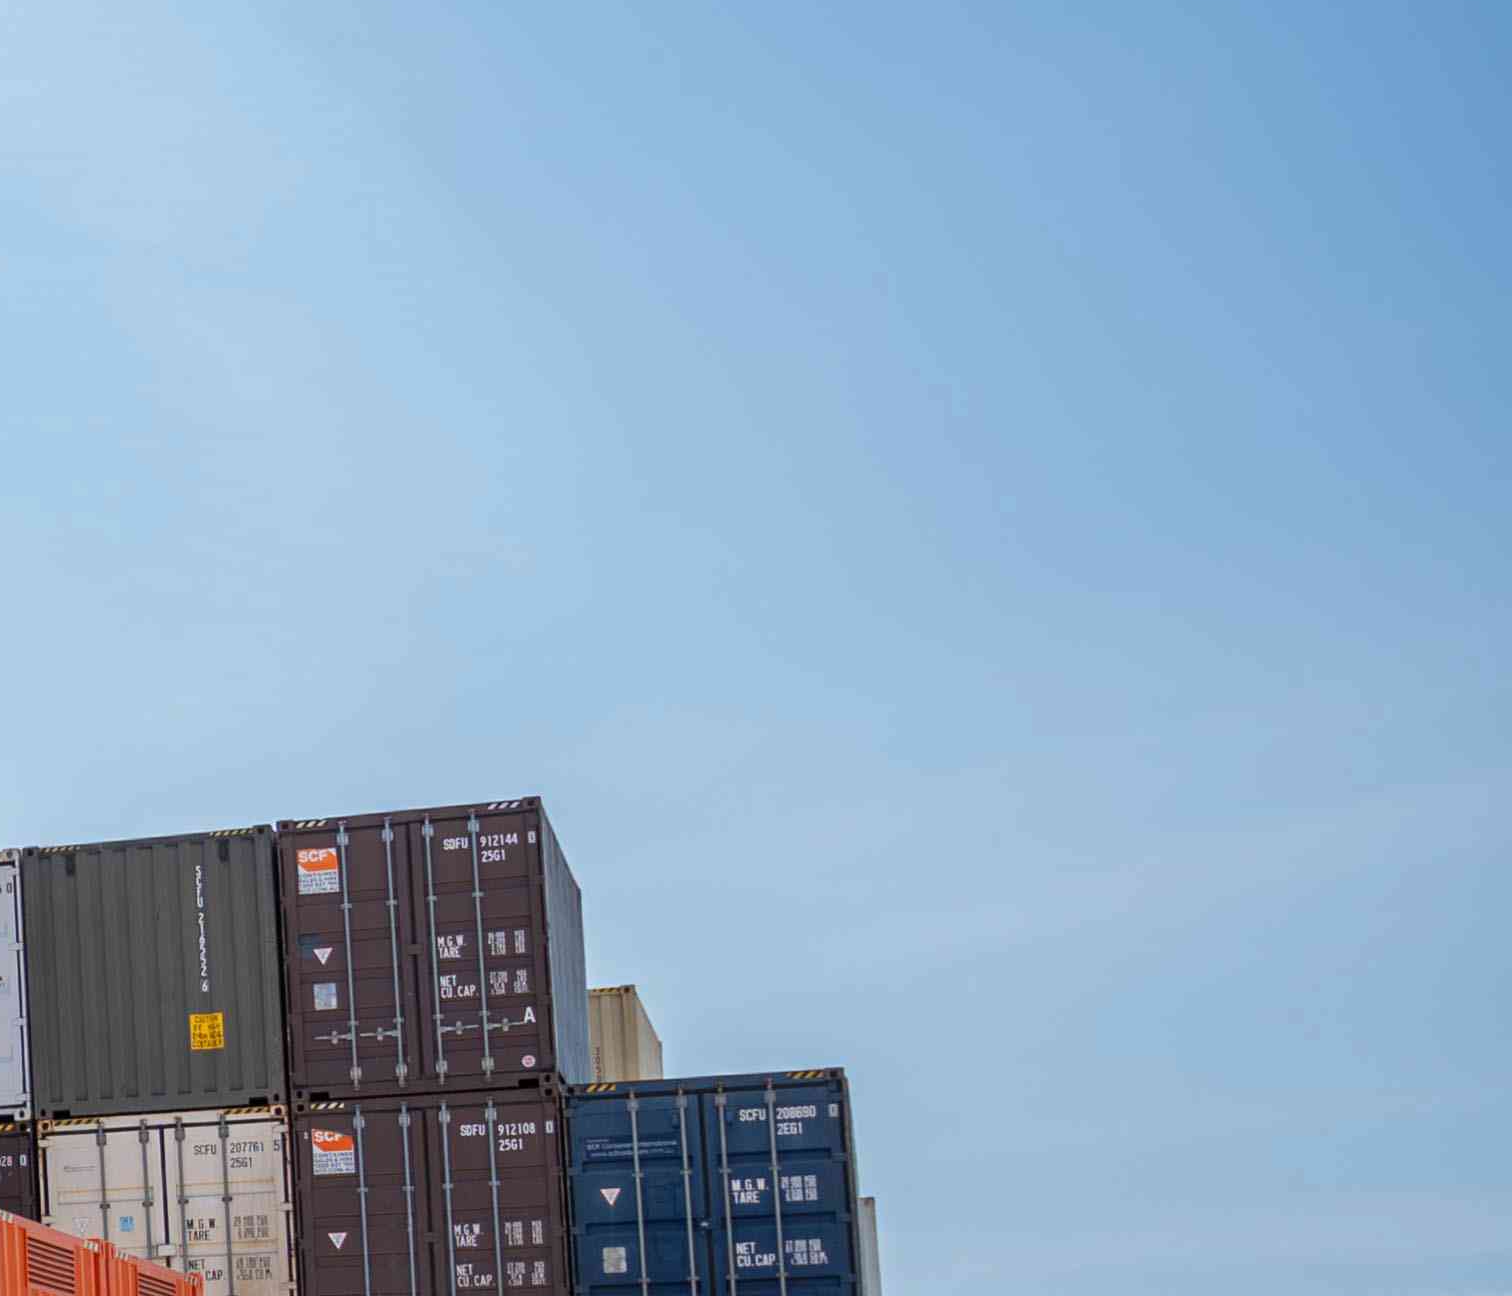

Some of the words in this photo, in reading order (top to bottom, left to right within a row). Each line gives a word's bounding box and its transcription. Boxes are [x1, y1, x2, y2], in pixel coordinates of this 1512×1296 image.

[480, 833, 518, 847] 912144
[298, 851, 329, 863] SCF
[481, 850, 506, 862] 25G1
[438, 947, 461, 958] TARE
[440, 975, 457, 986] NET
[523, 1007, 536, 1023] A
[739, 1108, 766, 1121] SCFU
[498, 1122, 535, 1135] 912108
[776, 1122, 803, 1135] 2EG1
[498, 1139, 523, 1151] 25G1
[230, 1157, 252, 1168] 25G1
[732, 1191, 760, 1203] TARE
[188, 1231, 210, 1241] TARE
[455, 1235, 477, 1247] TARE
[736, 1242, 756, 1254] NET
[188, 1259, 205, 1271] NET
[457, 1264, 473, 1276] NET
